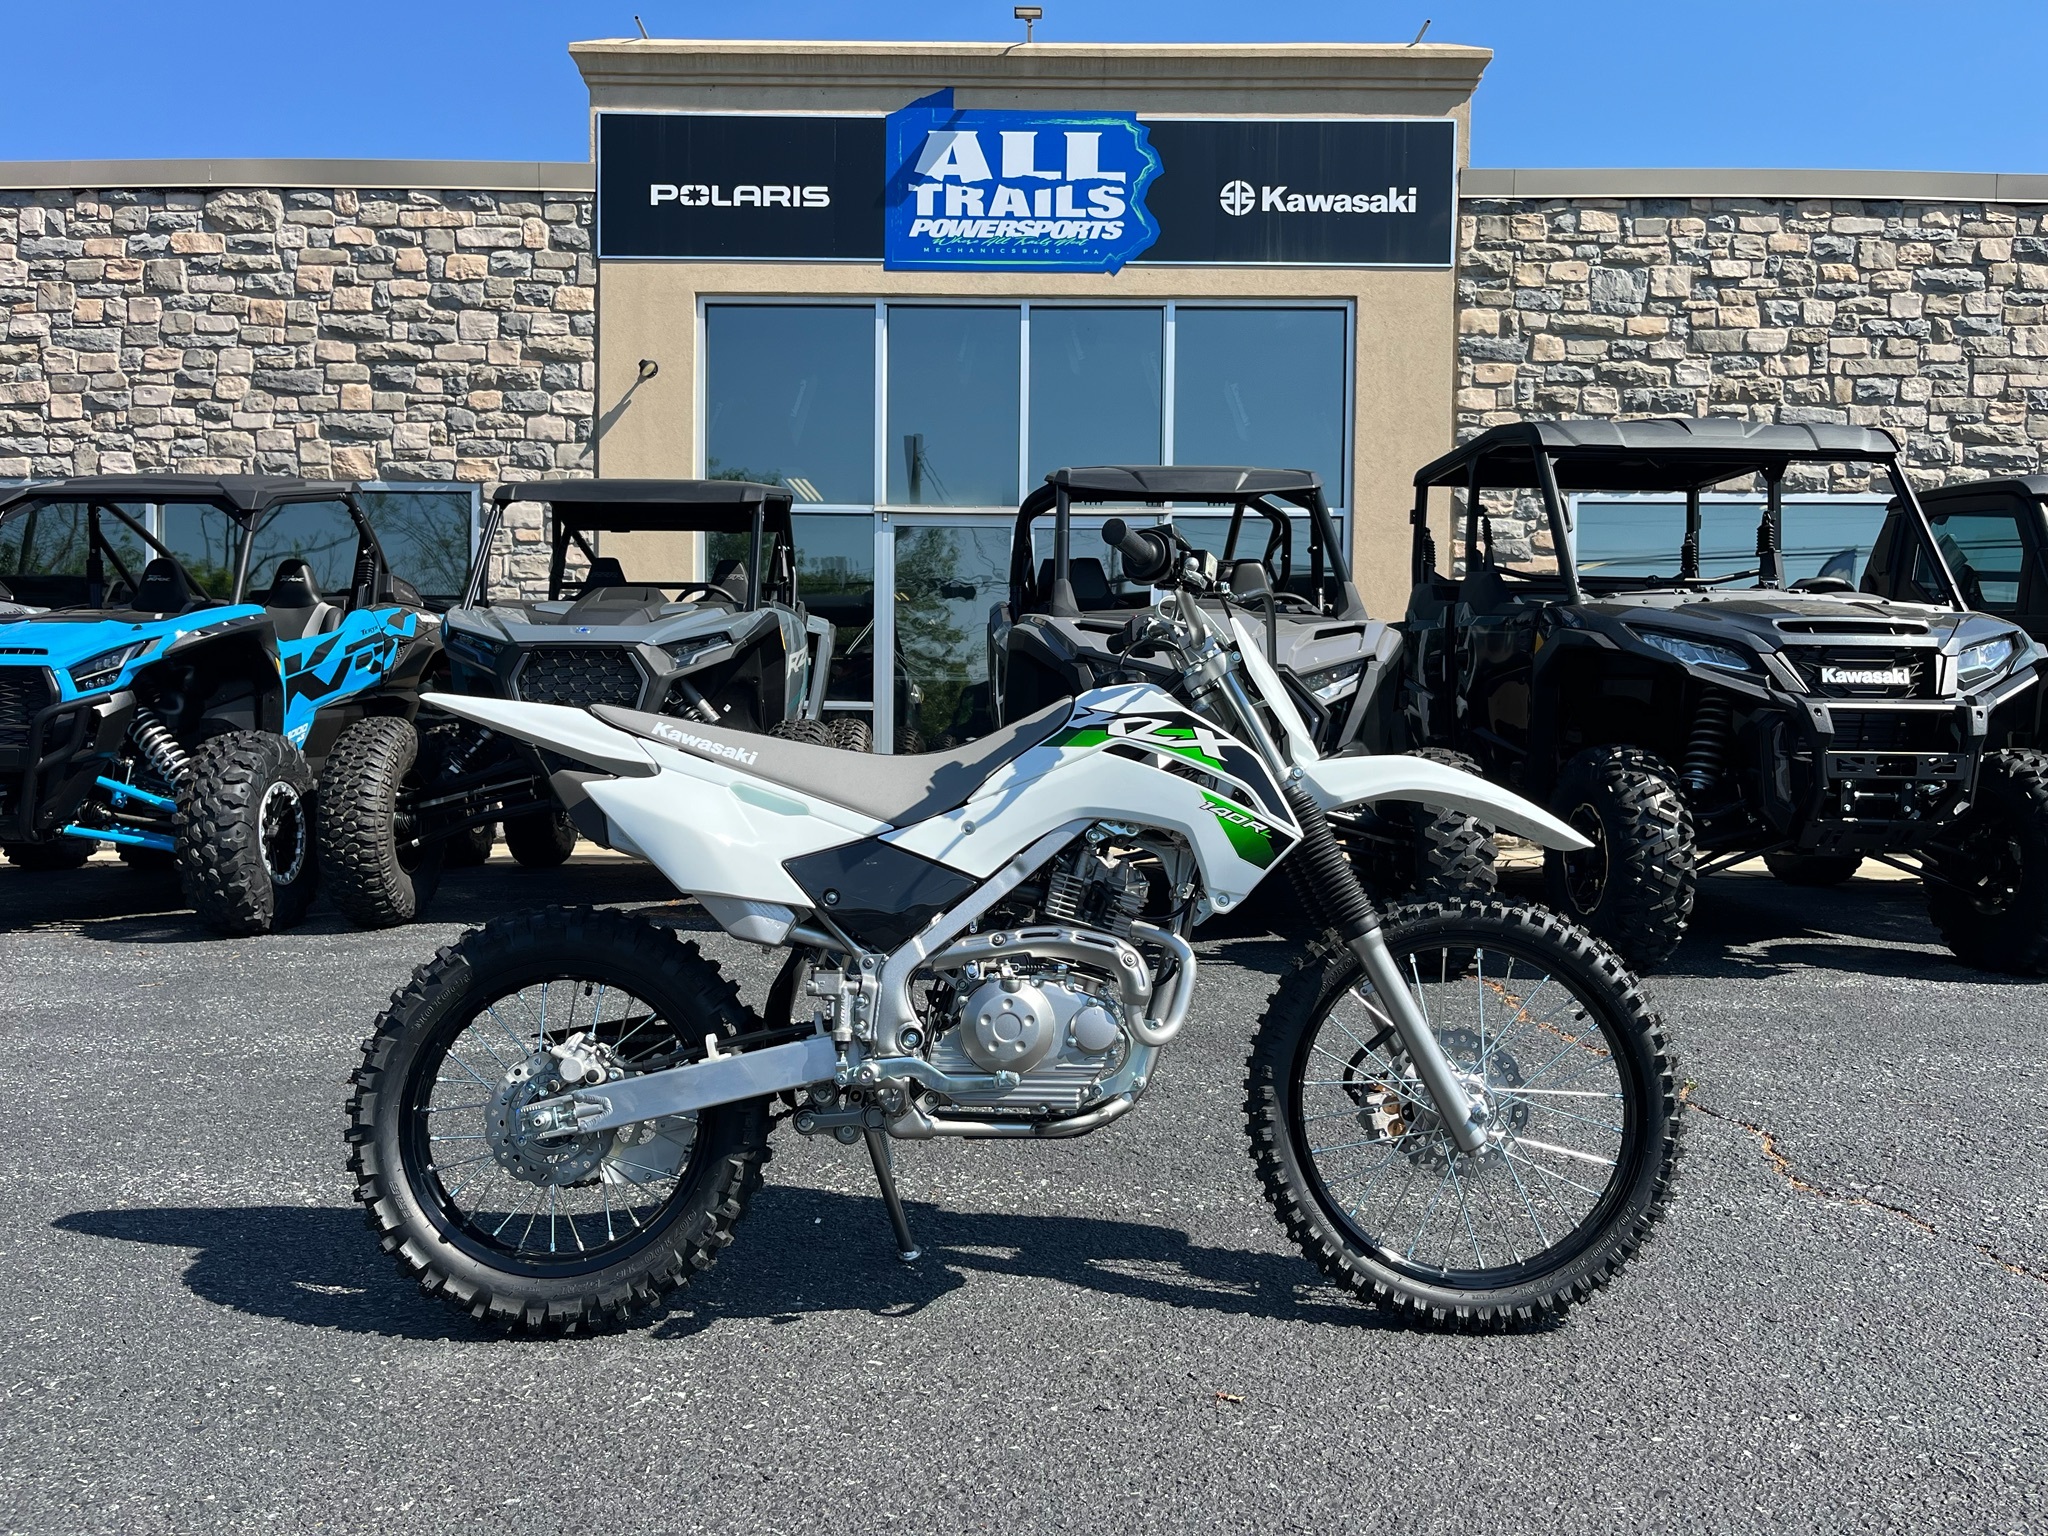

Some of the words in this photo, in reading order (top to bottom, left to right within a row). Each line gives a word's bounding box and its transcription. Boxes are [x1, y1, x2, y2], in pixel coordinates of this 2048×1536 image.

[914, 131, 1126, 184] ALL
[650, 184, 831, 208] POLARIS
[908, 182, 1126, 218] TRAILS
[1261, 186, 1417, 213] Kawasaki
[908, 218, 1125, 240] POWERSPORTS
[1821, 667, 1911, 685] Kawasaki
[650, 721, 759, 766] Kawasaki
